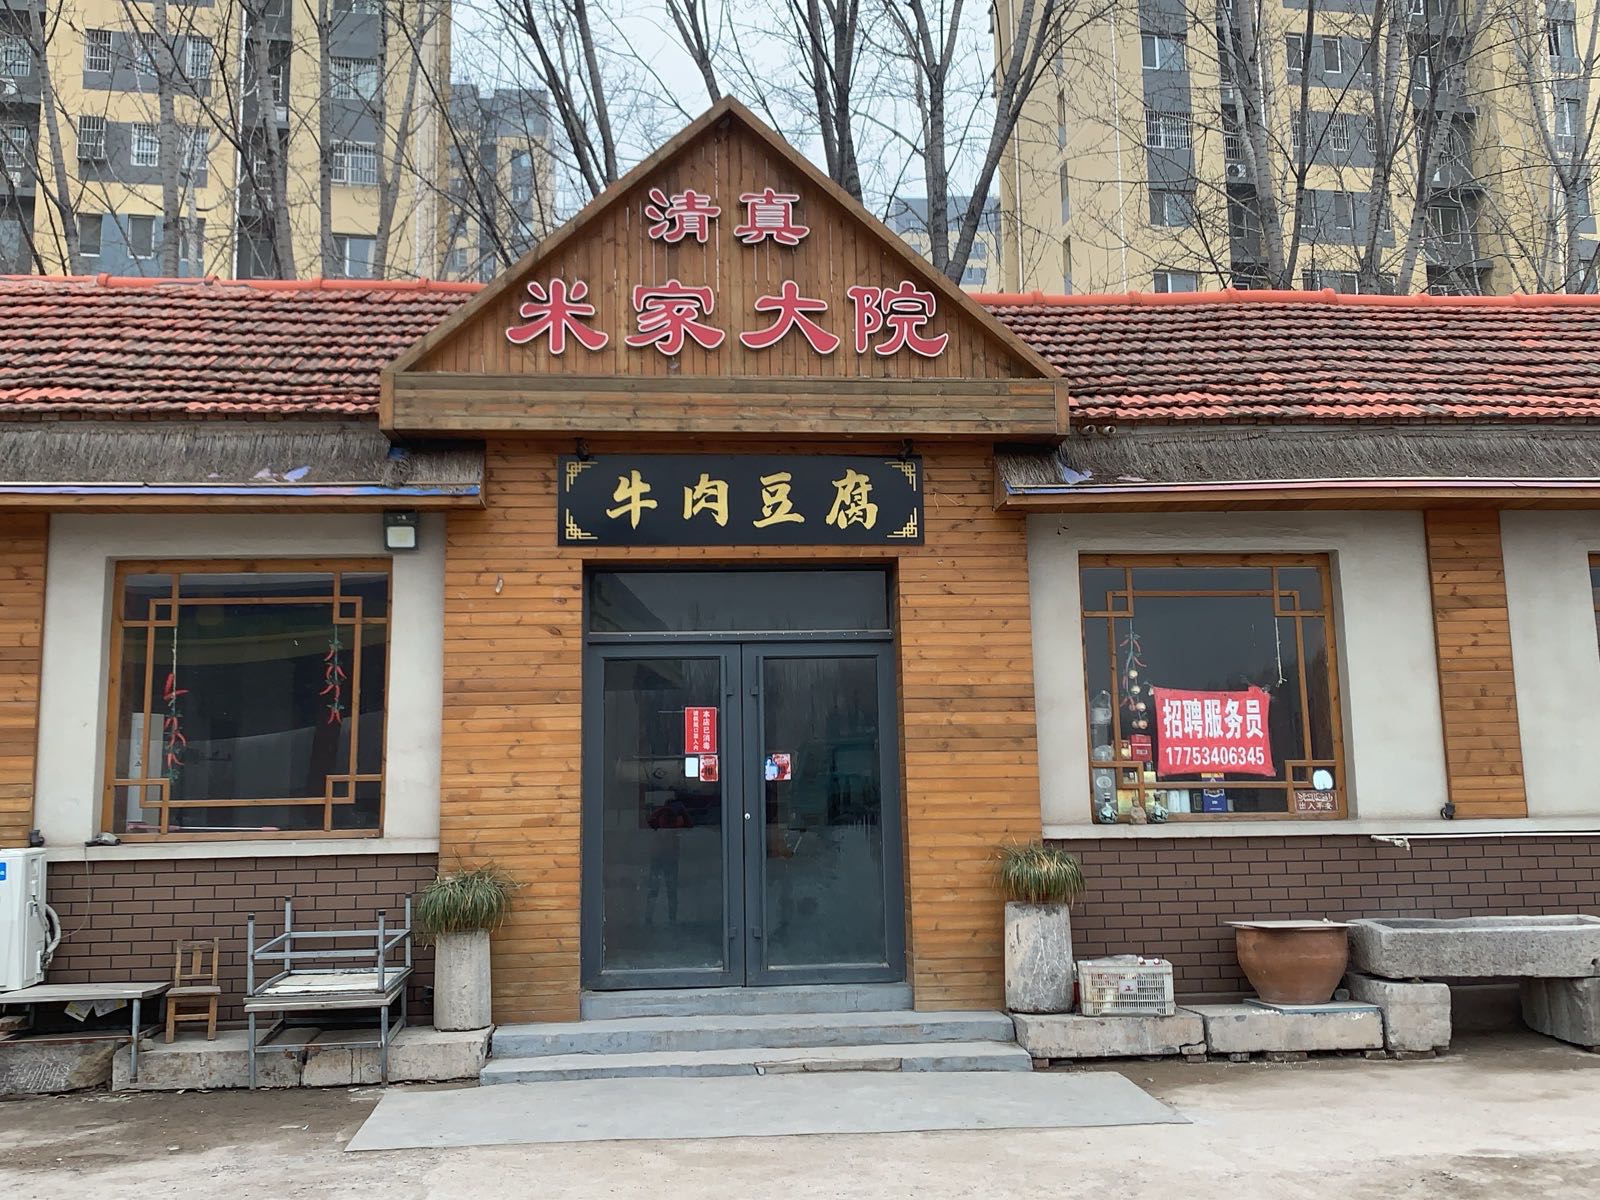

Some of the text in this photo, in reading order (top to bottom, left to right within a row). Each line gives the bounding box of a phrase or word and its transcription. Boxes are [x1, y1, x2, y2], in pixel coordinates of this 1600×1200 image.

[644, 187, 810, 246] 清真
[505, 278, 950, 358] 米家大院
[606, 468, 879, 530] 牛肉豆腐
[1163, 698, 1264, 740] 招聘服务员
[1166, 746, 1265, 766] 17753406345
